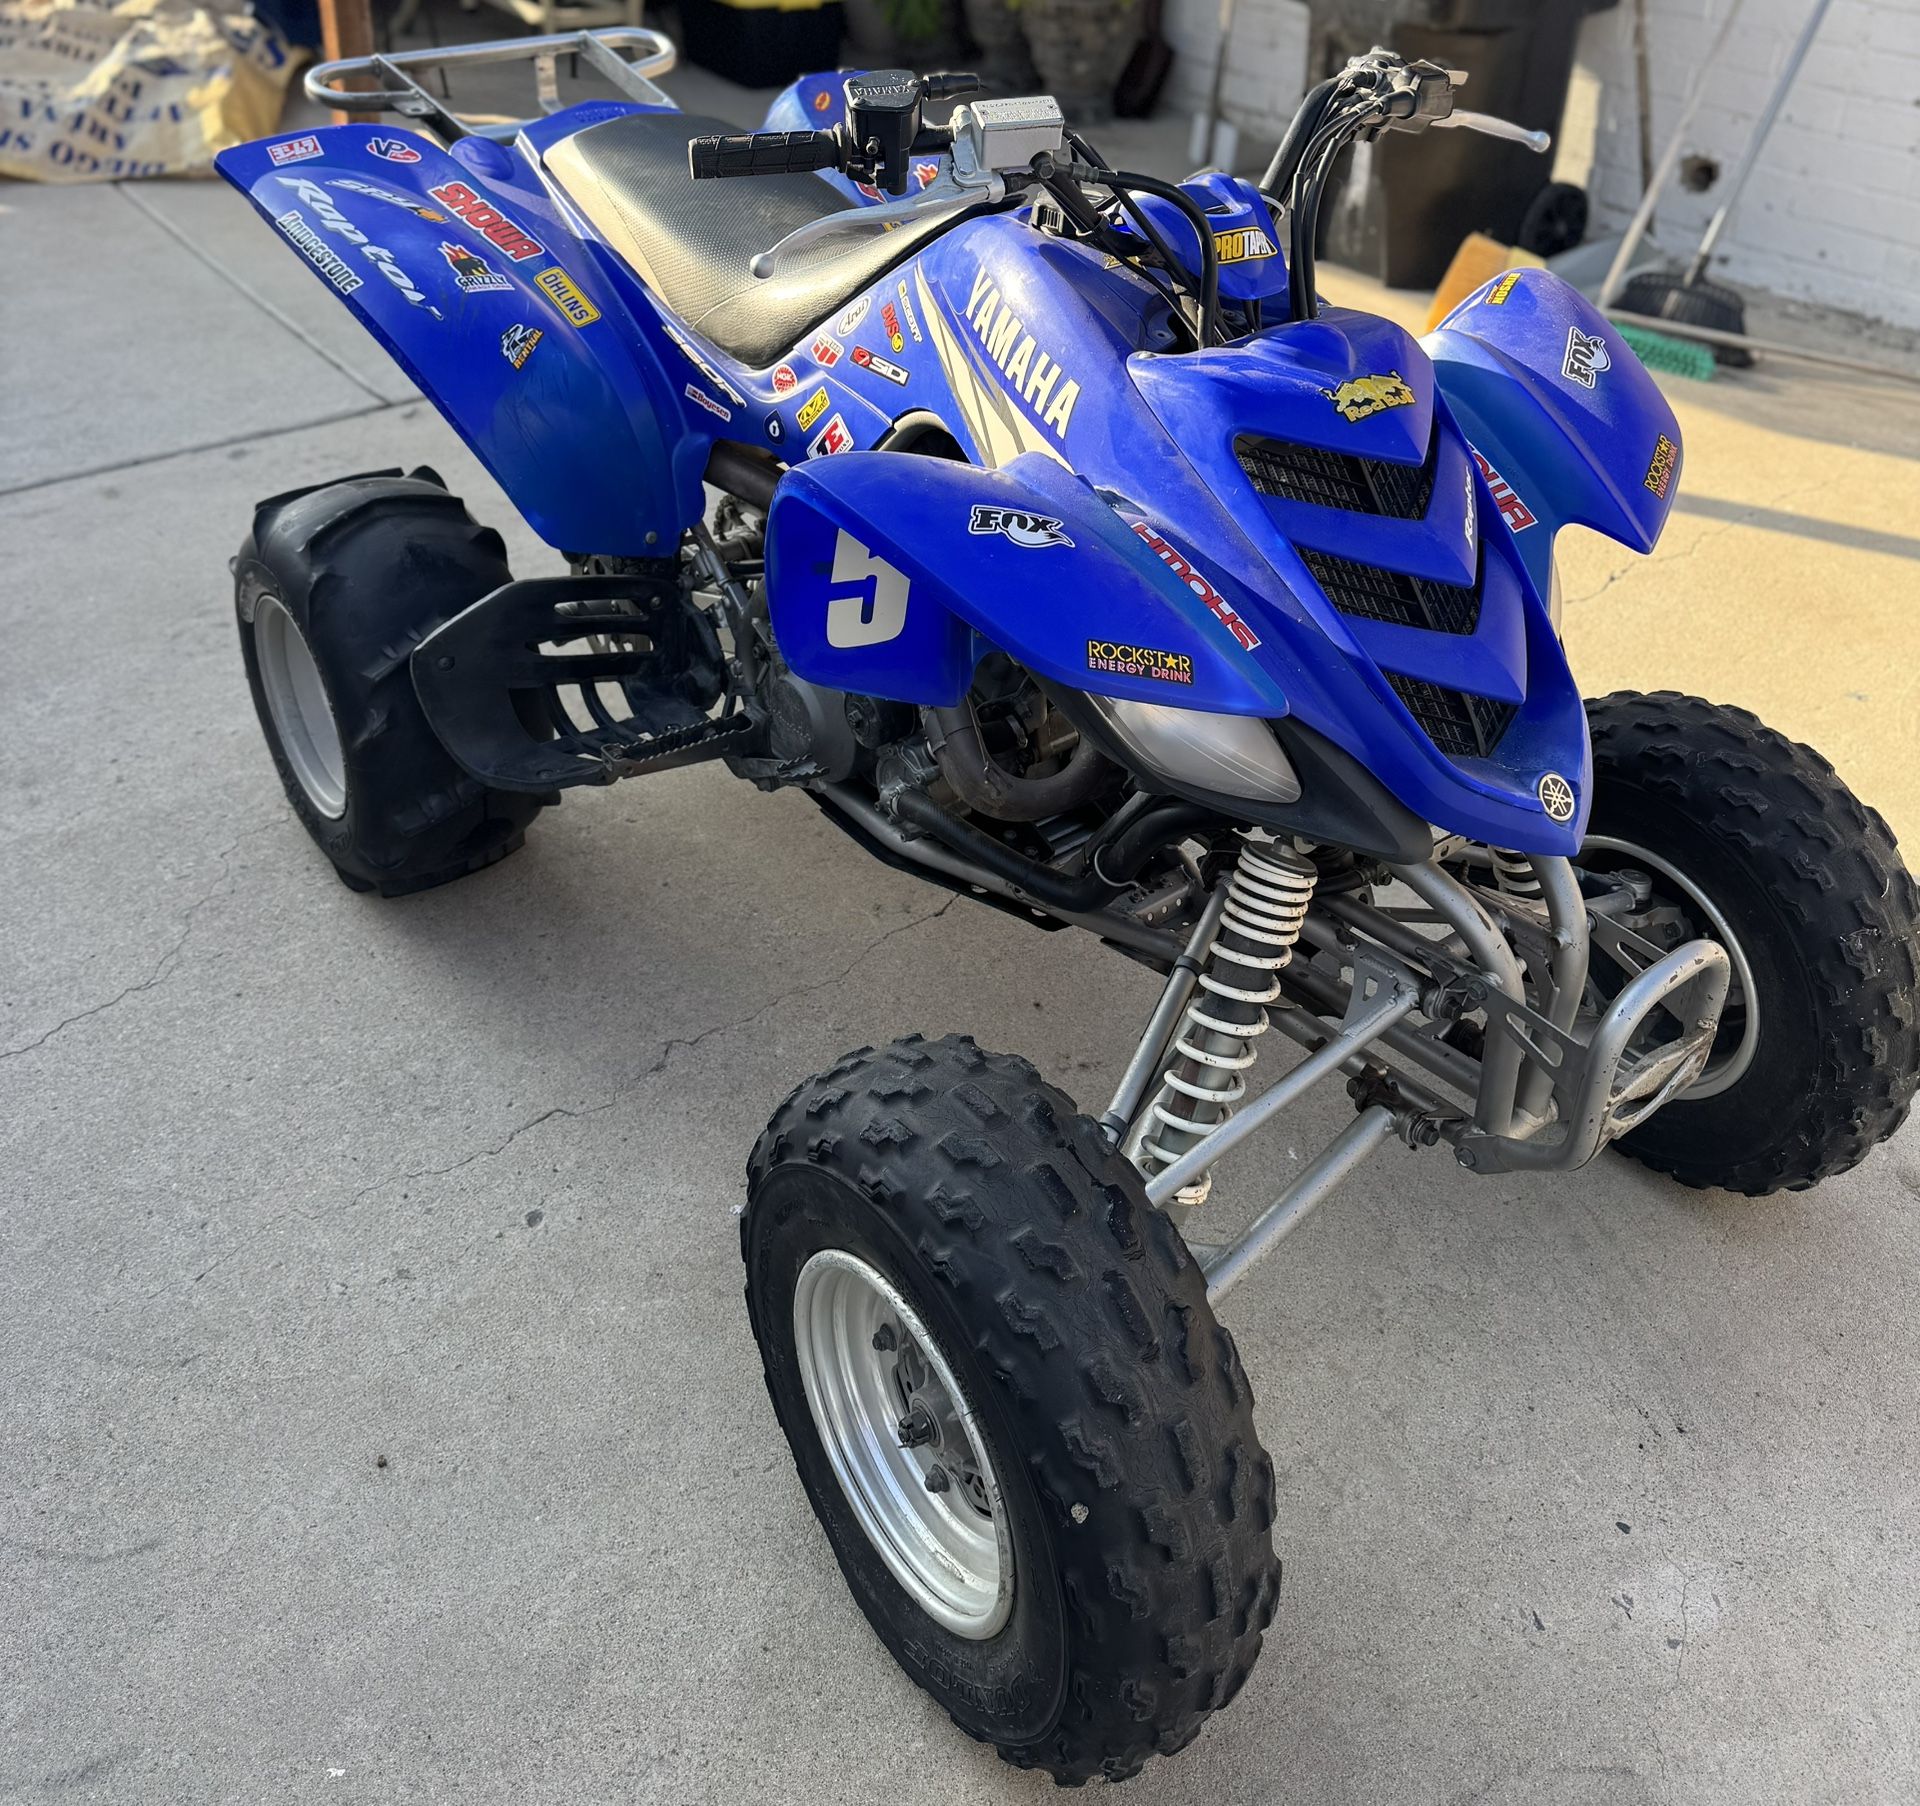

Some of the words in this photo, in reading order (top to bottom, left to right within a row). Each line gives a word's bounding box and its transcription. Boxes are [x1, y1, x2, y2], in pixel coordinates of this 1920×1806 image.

[371, 137, 407, 158] VP
[430, 182, 544, 261] SHOWA
[275, 176, 444, 321] Raptor
[277, 211, 362, 293] BRIDGESTONE
[457, 274, 509, 288] GRIZZLY
[880, 301, 899, 338] DVS
[513, 328, 544, 369] RENTHAL
[965, 264, 1082, 440] YAMAHA
[1569, 332, 1597, 385] FOX
[1344, 401, 1387, 422] Red
[1383, 389, 1416, 408] Bull
[975, 509, 1058, 533] FOX
[1132, 523, 1260, 650] SHOWA
[1088, 657, 1146, 676] ENERGY
[1151, 666, 1192, 684] DRINK
